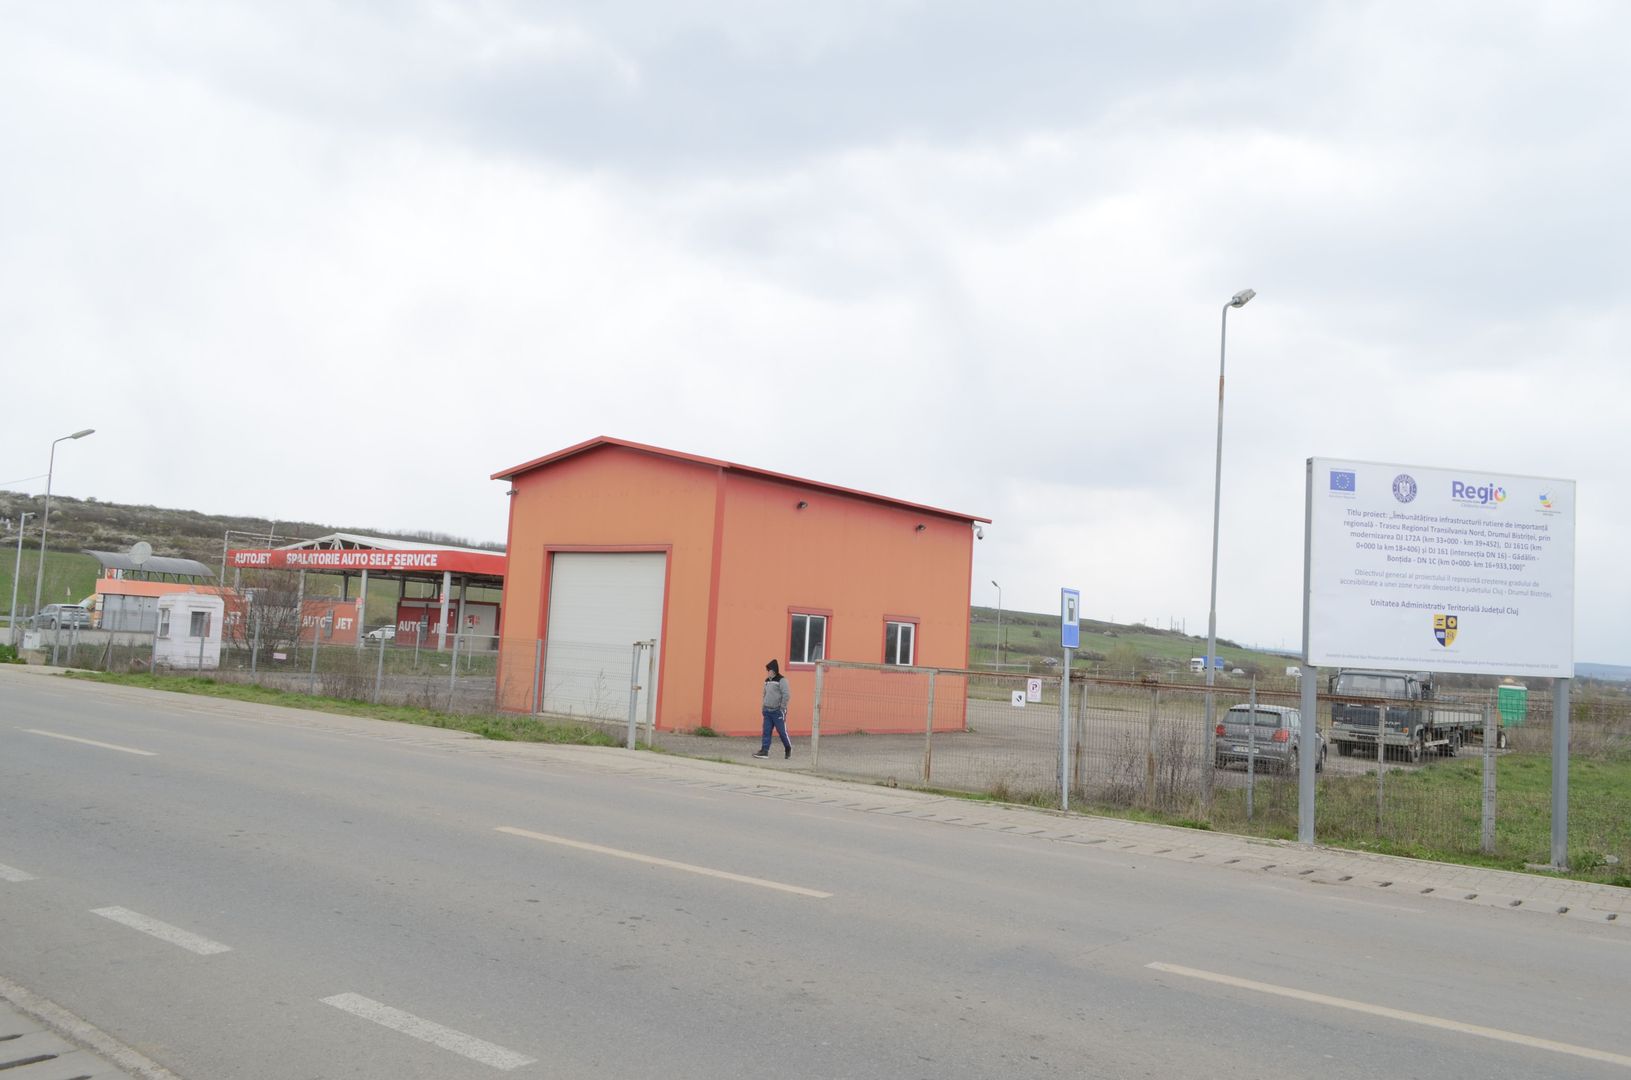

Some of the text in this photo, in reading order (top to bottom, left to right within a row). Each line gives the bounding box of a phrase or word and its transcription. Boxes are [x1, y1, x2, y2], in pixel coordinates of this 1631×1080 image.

[1452, 480, 1506, 504] Regio
[1363, 511, 1388, 520] proiect:
[1440, 514, 1482, 525] infrastructurii
[1344, 520, 1374, 528] regională
[1380, 522, 1400, 530] Traseu
[1402, 524, 1429, 532] Regional
[1430, 526, 1468, 535] Transilvania
[1469, 529, 1486, 537] Nord,
[1488, 530, 1510, 538] Drumul
[1512, 532, 1537, 541] Bistriței,
[1350, 531, 1394, 540] modernizarea
[1436, 536, 1458, 544] 33+000
[1396, 545, 1420, 554] 18+406)
[1450, 548, 1484, 558] (intersecția
[234, 553, 438, 566] AUTOJET SPALATORIE AUTO SELF SERVICE
[1387, 554, 1412, 563] Bonțida
[1438, 558, 1450, 566] (km
[1370, 599, 1518, 616] Unitatea Administrativ Teritorială Județul Cluj
[335, 616, 353, 630] JET
